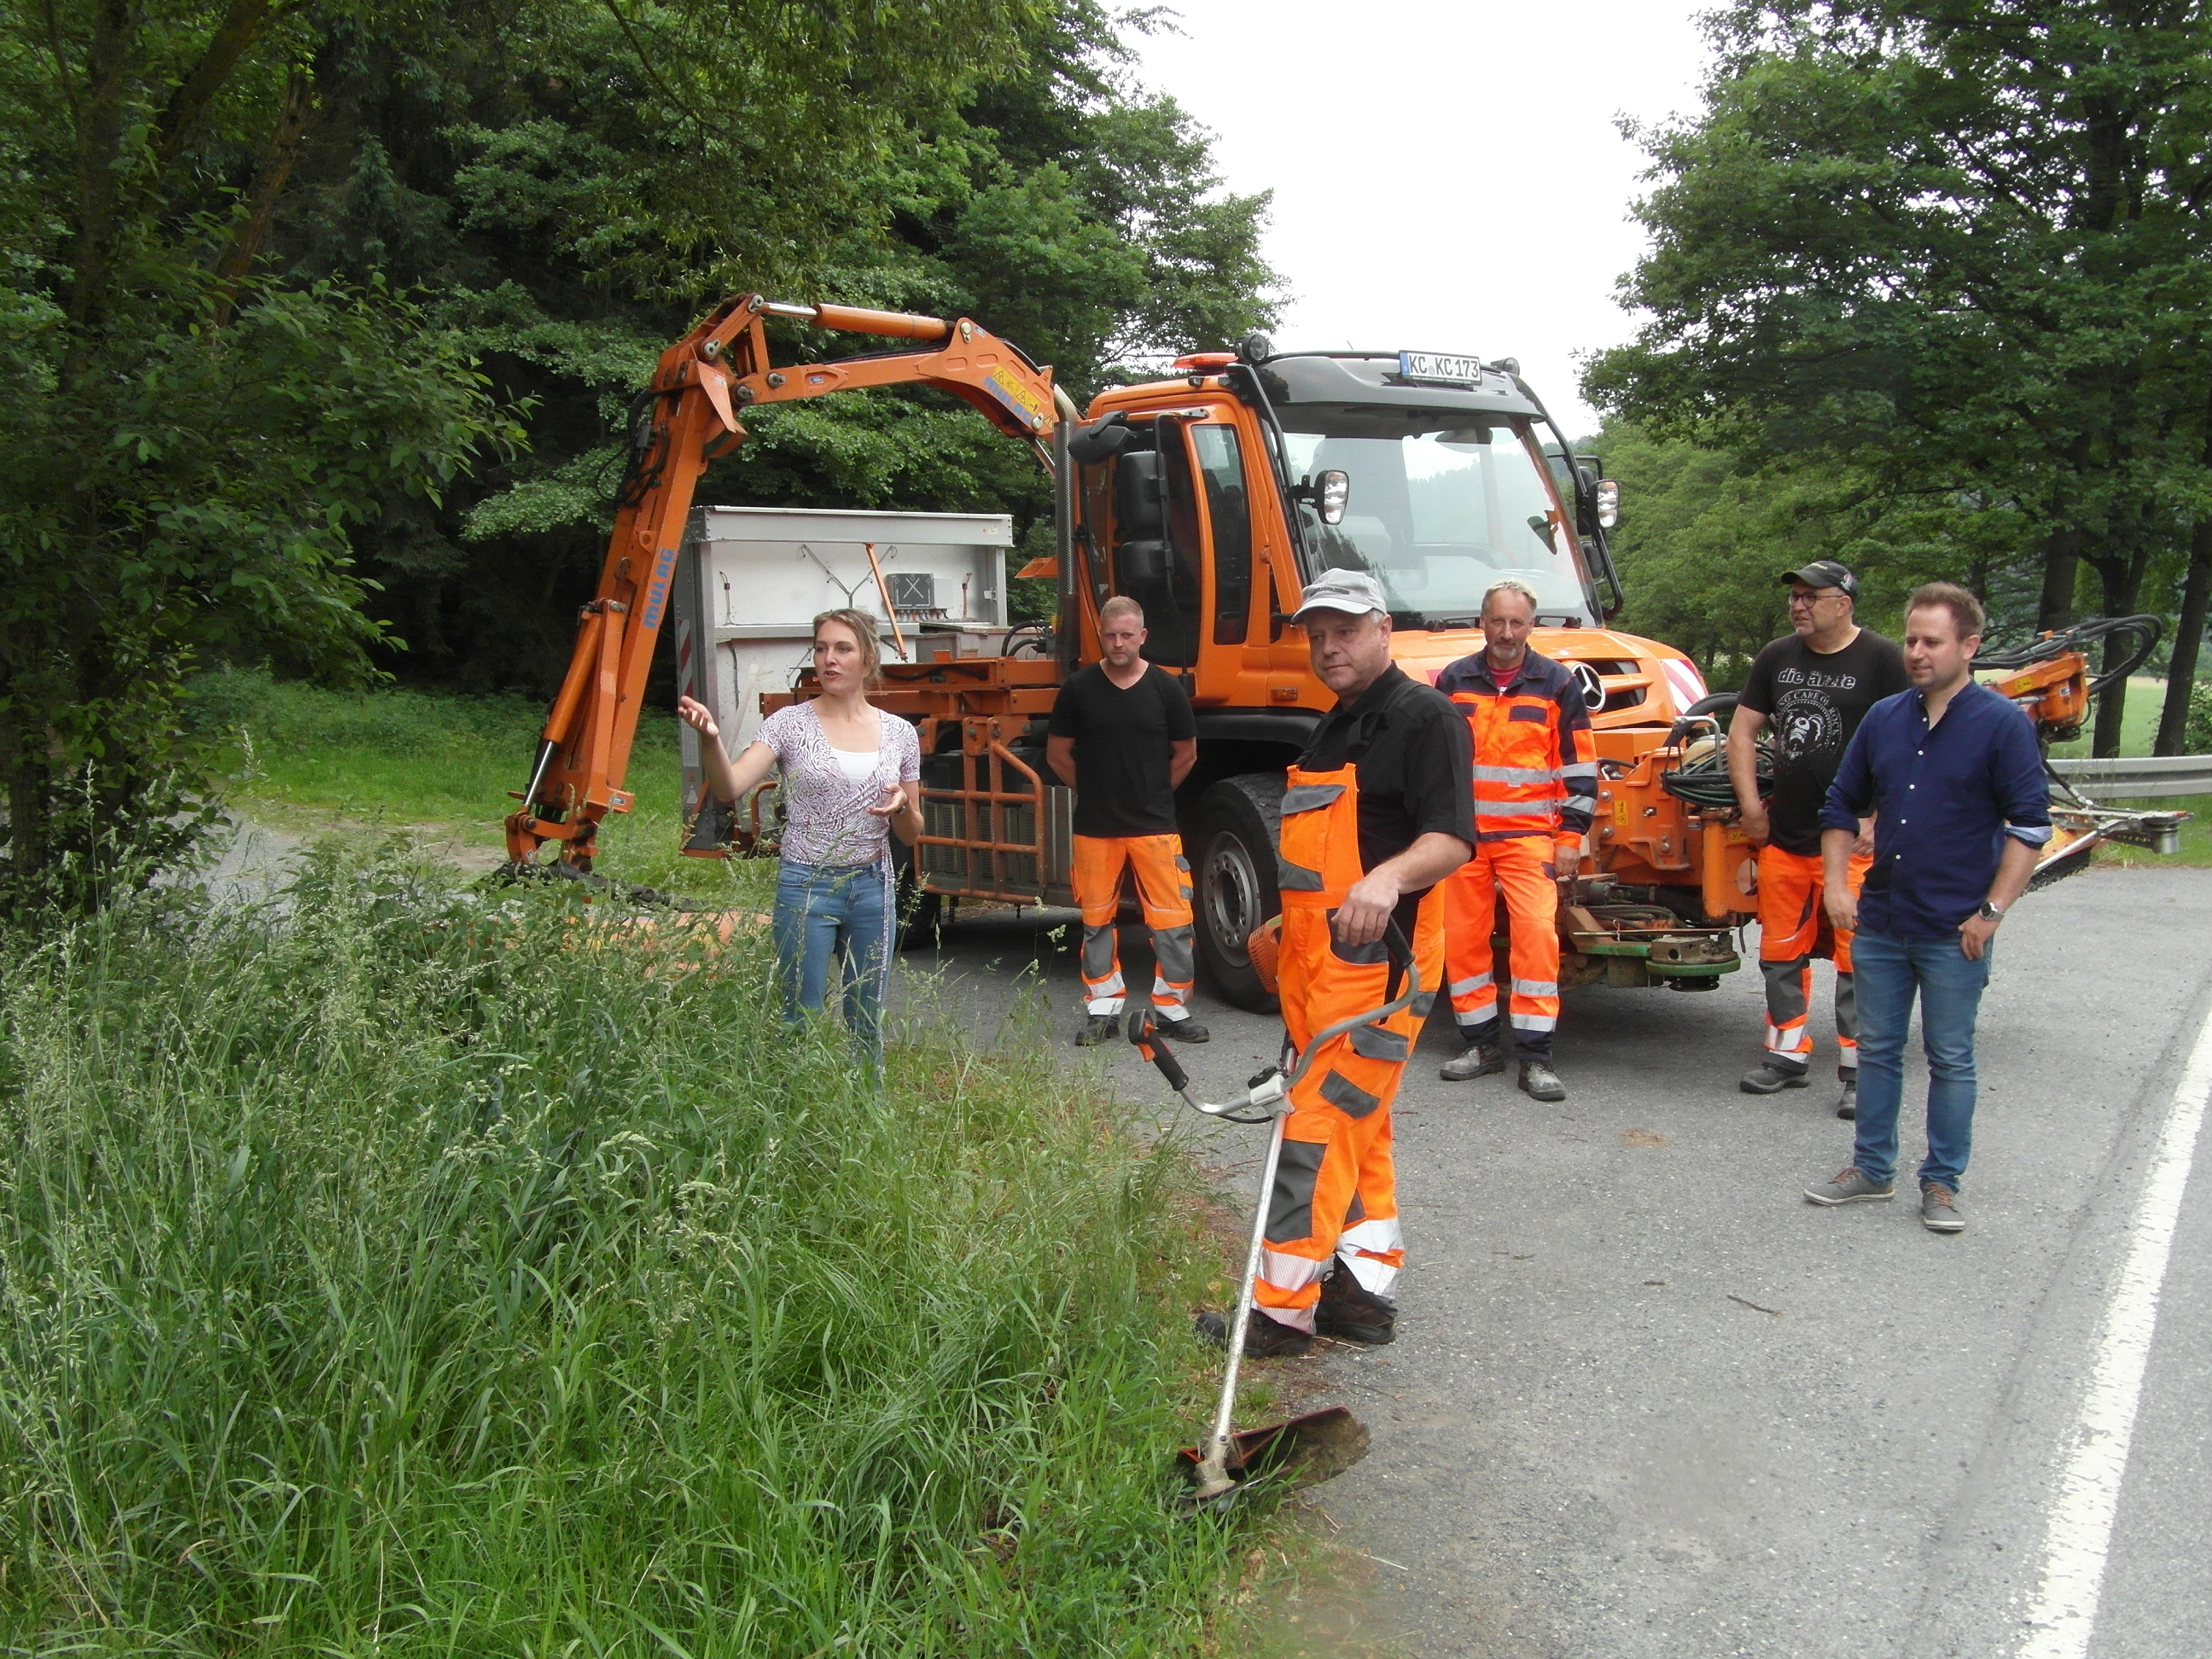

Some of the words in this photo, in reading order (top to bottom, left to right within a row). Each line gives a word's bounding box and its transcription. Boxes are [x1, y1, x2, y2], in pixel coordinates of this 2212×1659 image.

[1409, 355, 1427, 374] KC
[1435, 357, 1452, 375] KC
[1455, 358, 1479, 378] 173
[1778, 667, 1805, 684] die
[1793, 691, 1819, 701] CARE
[1828, 707, 1840, 736] ROCK
